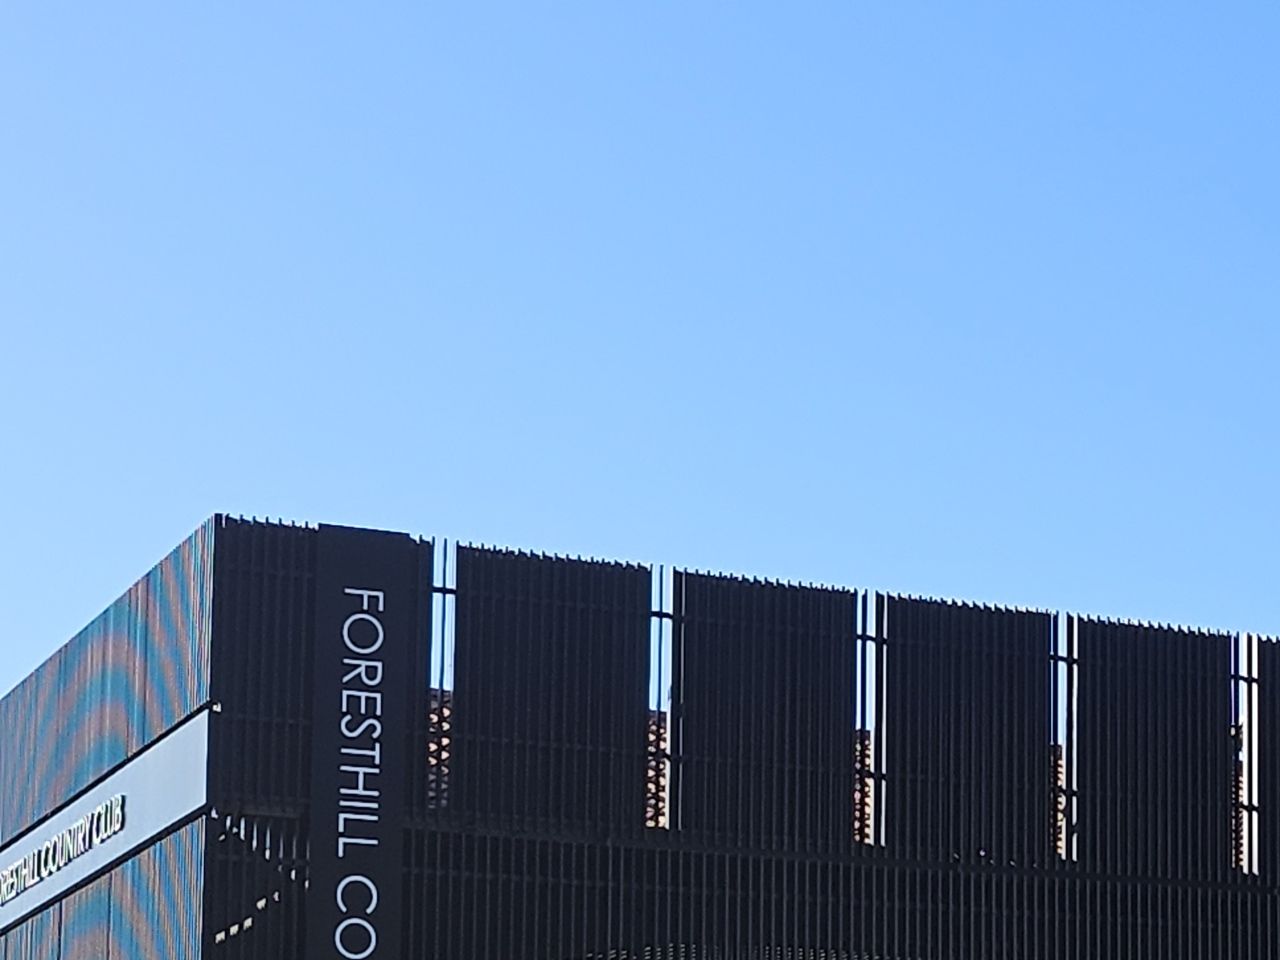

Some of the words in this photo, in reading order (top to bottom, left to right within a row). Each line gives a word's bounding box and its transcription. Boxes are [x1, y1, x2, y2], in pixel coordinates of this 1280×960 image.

[339, 588, 383, 857] FORESTHILL
[40, 813, 92, 877] COUNTRY
[92, 793, 124, 844] CLUB
